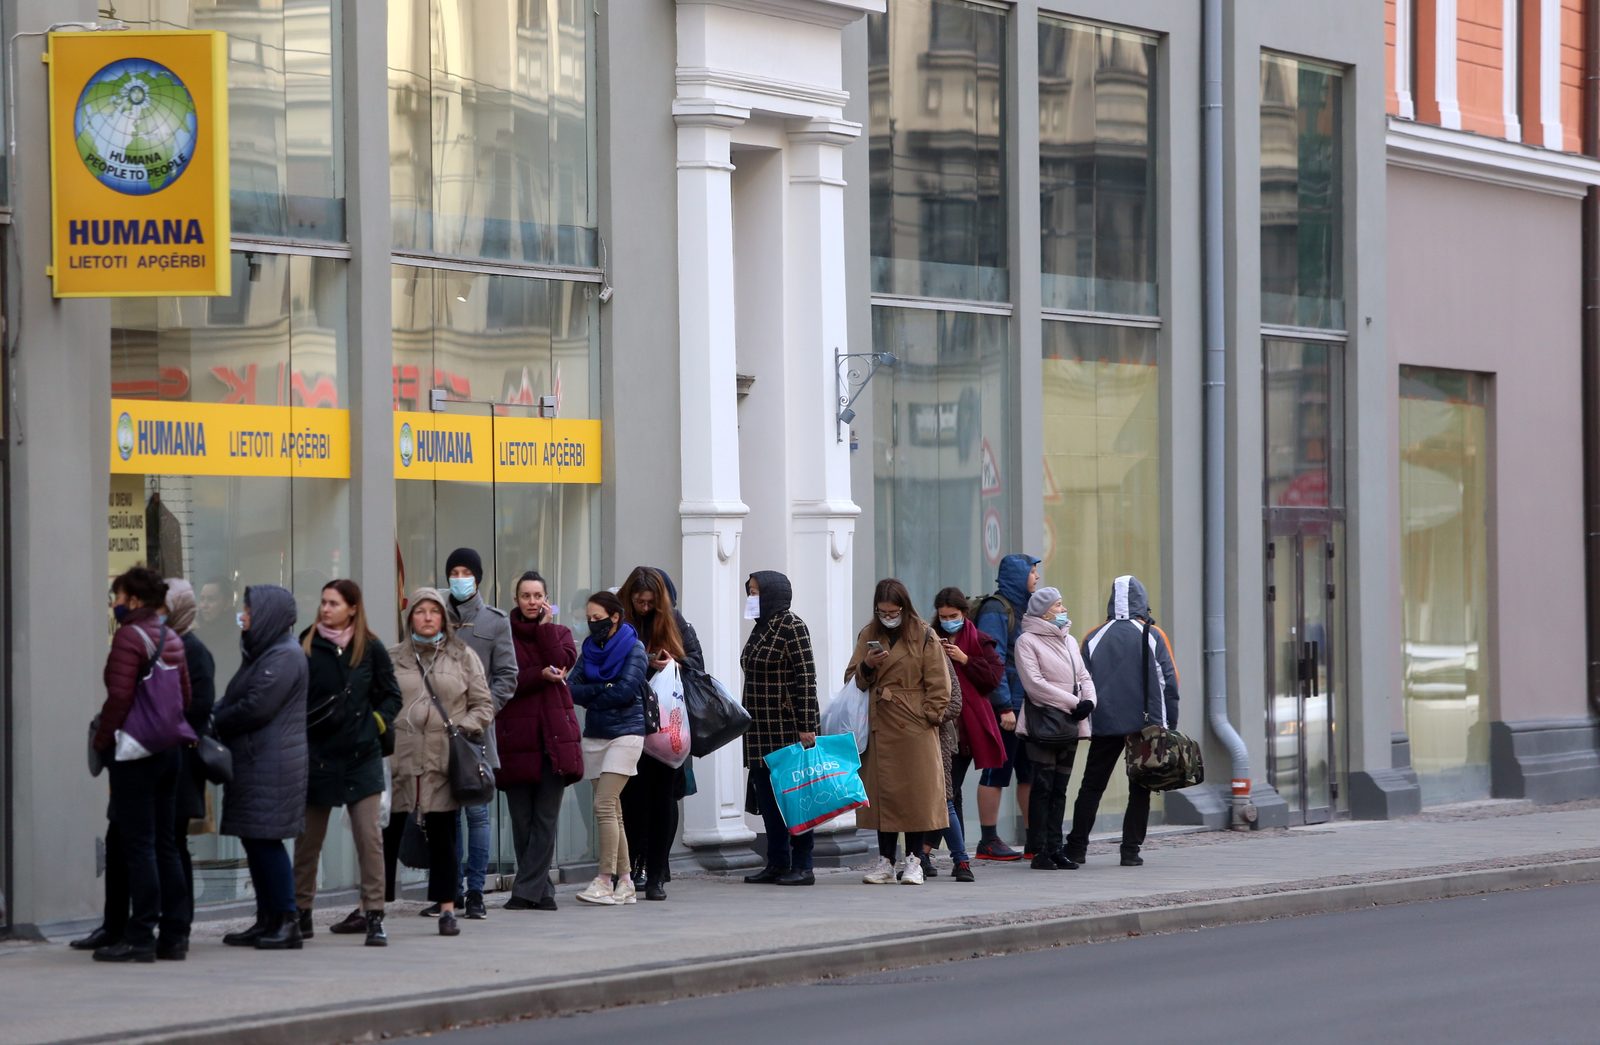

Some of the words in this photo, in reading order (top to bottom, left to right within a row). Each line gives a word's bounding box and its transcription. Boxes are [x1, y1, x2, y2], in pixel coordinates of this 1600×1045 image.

[86, 153, 127, 180] PEOPLE
[129, 170, 145, 180] TO
[147, 153, 188, 179] PEOPLE
[109, 150, 162, 166] HUMANA
[69, 219, 205, 246] HUMANA
[69, 255, 128, 269] LIETOTI
[137, 251, 206, 272] APĢĒRBI
[137, 420, 207, 457] HUMANA
[229, 431, 273, 458] LIETOTI
[280, 428, 331, 467] APĢĒRBI
[417, 430, 474, 464] HUMANA
[500, 441, 537, 466] LIETOTI
[542, 438, 585, 474] APĢĒRBI
[792, 760, 840, 783] Drogas
